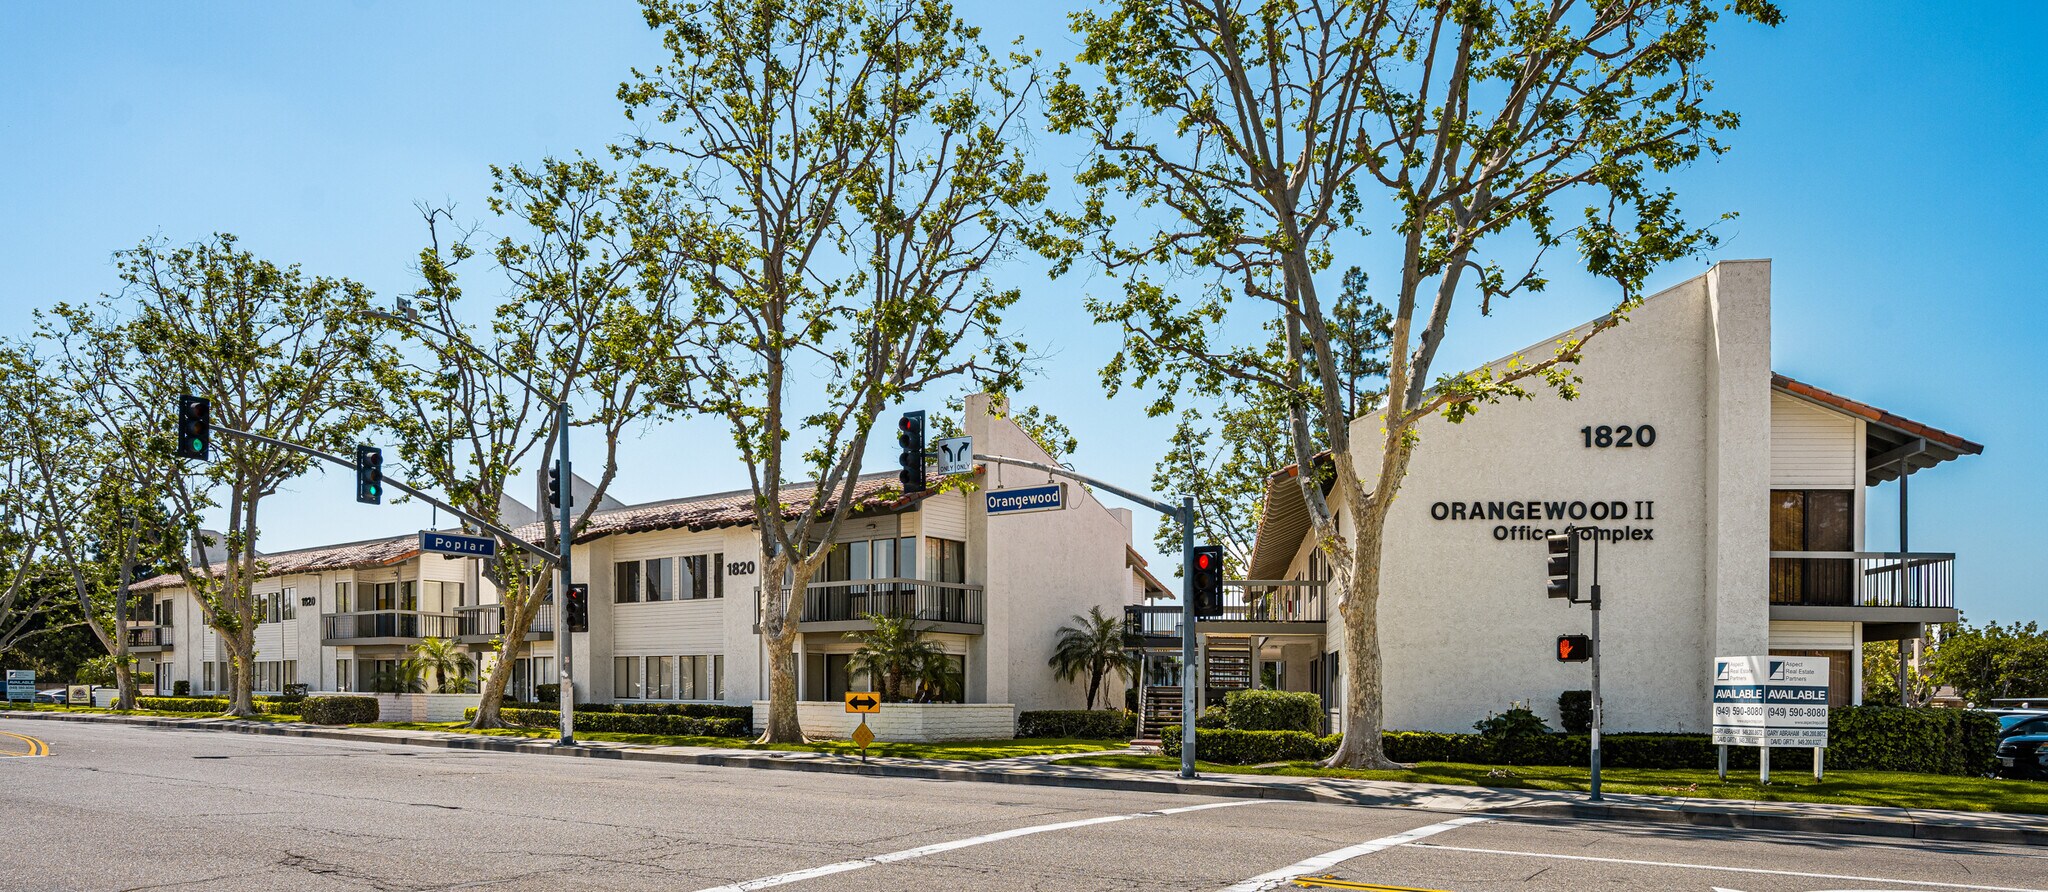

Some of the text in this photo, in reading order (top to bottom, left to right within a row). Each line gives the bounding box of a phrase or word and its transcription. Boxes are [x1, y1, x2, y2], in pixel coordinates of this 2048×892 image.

[1580, 424, 1657, 448] 1820
[940, 463, 971, 473] ONLY ONLY
[988, 491, 1059, 509] Orangewood
[1431, 500, 1655, 521] ORANGEWOOD II
[1493, 525, 1556, 541] Office
[435, 537, 485, 552] Poplar
[727, 561, 756, 576] 1820
[1715, 689, 1763, 699] AVAILABLE
[1767, 689, 1826, 700] AVAILABLE
[1715, 706, 1763, 717] (949) 590-8080
[1767, 707, 1827, 718] (949) 590-8080
